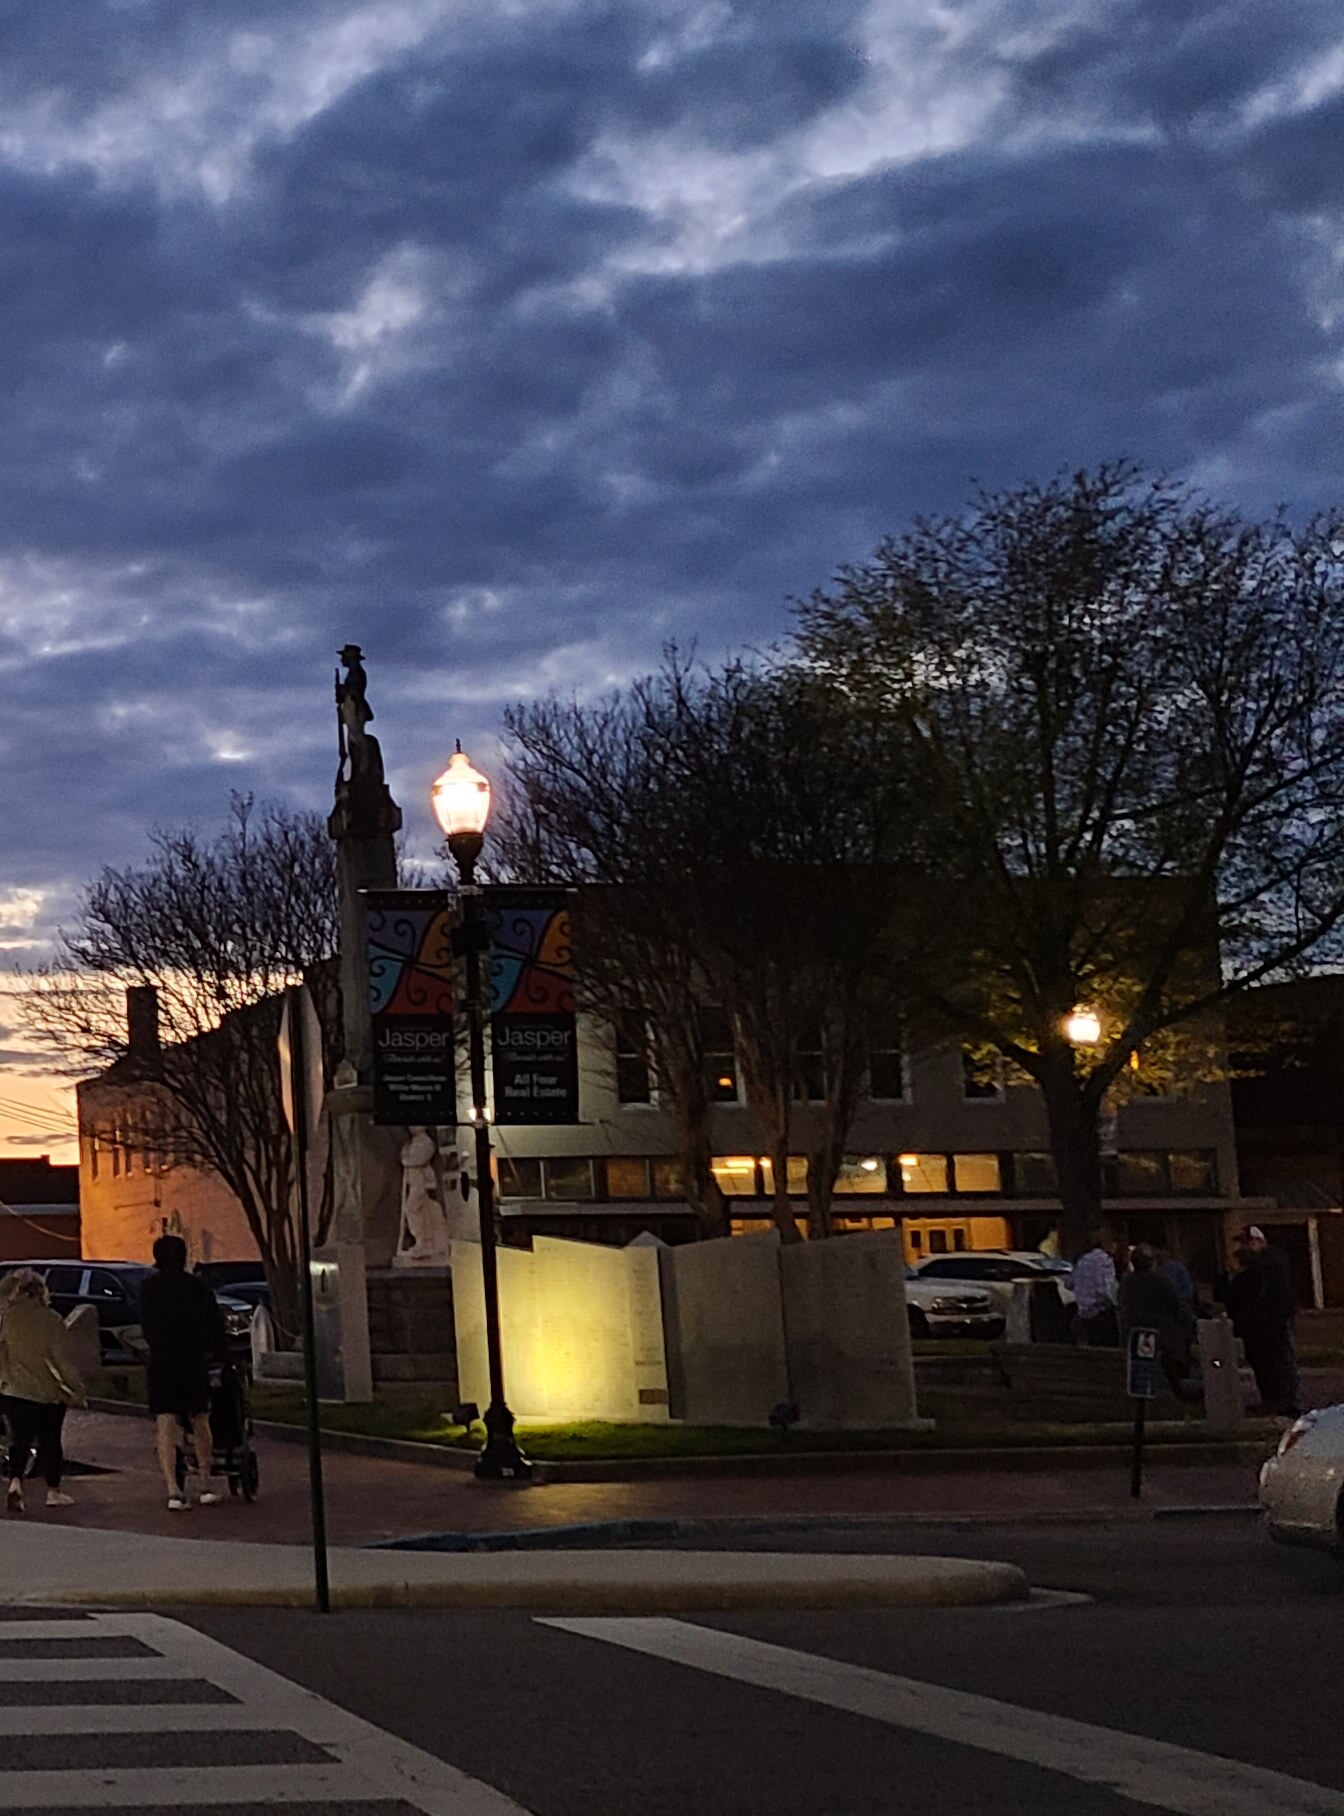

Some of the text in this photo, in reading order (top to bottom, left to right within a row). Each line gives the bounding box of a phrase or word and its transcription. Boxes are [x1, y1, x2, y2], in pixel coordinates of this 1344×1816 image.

[377, 1027, 450, 1052] Jasper
[496, 1026, 572, 1049] Jasper
[514, 1073, 558, 1085] All Four
[504, 1086, 568, 1098] Real Estate
